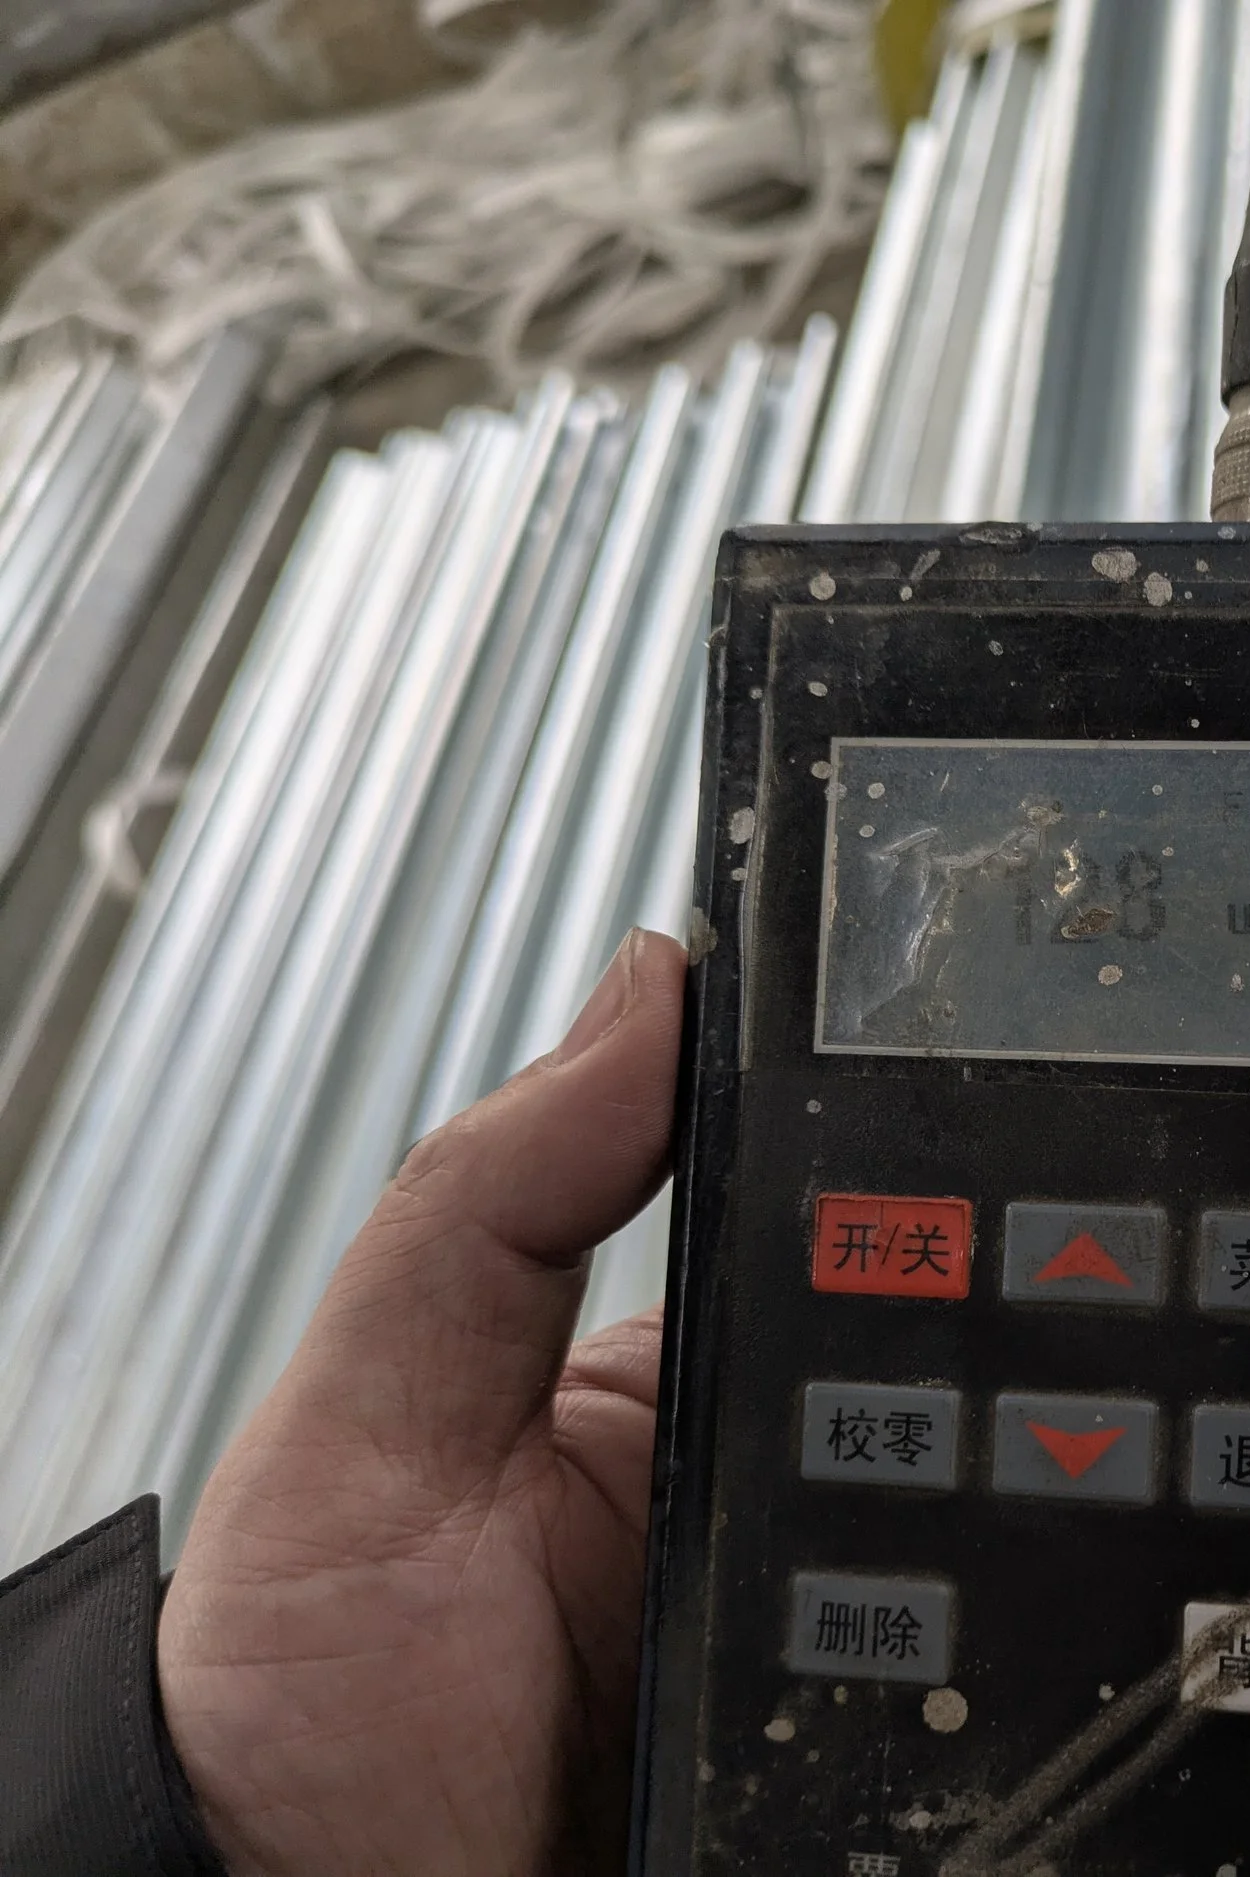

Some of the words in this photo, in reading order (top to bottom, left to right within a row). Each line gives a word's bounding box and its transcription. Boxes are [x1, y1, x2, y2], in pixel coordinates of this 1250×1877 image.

[832, 1223, 950, 1276] 开/关
[827, 1407, 933, 1467] 校零
[814, 1601, 922, 1660] 删除
